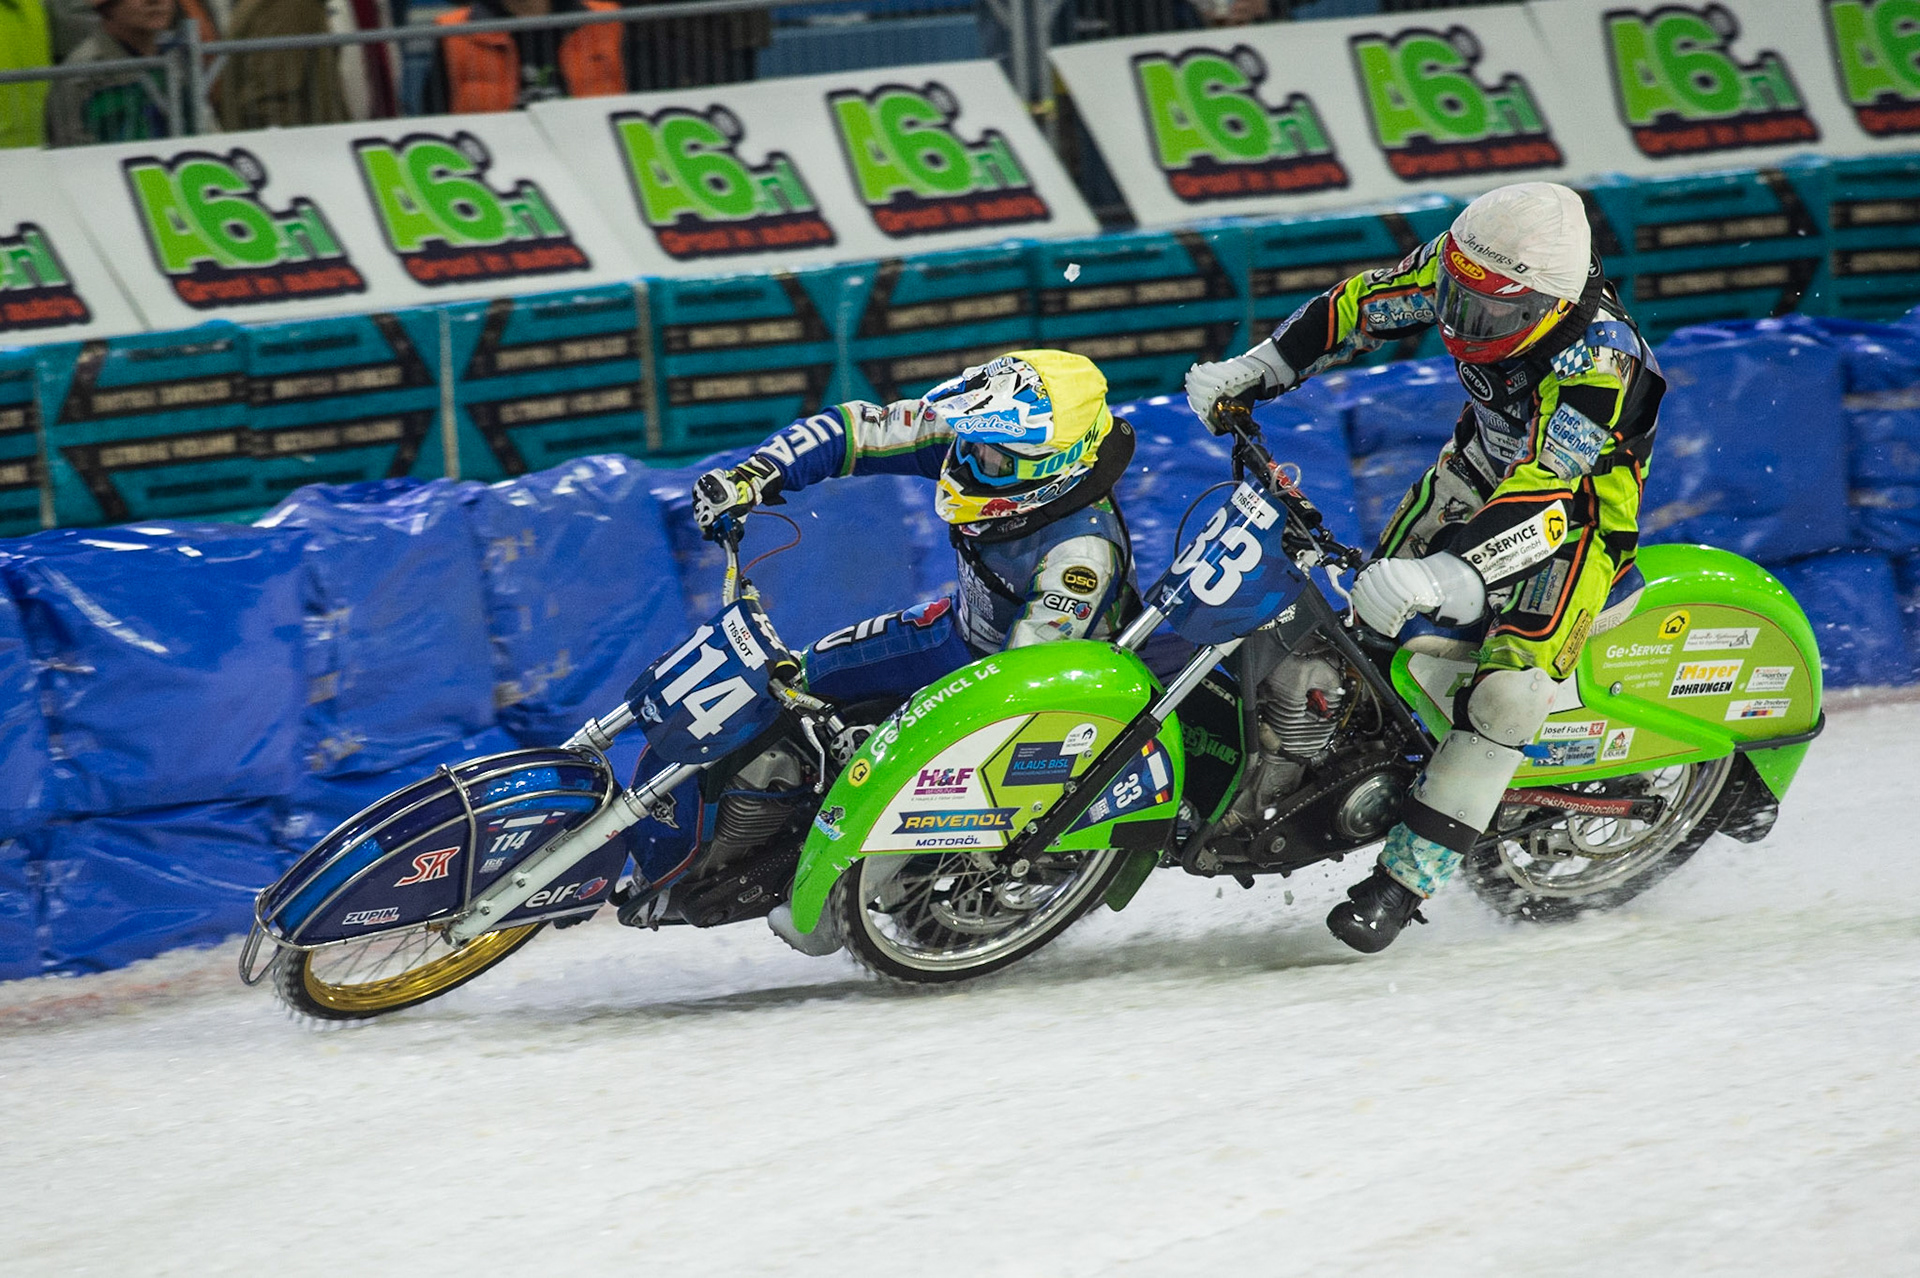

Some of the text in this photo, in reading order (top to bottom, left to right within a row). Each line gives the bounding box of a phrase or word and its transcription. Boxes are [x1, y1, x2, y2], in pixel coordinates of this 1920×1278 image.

[1556, 408, 1581, 430] msc
[756, 414, 844, 467] UFA
[1031, 422, 1099, 478] 100%
[1171, 507, 1262, 606] 33
[1044, 594, 1078, 612] elf
[727, 620, 753, 657] TISSOT
[654, 624, 757, 740] 114
[1681, 664, 1740, 682] Mayer
[1670, 680, 1733, 696] BOHRUNGEN
[901, 677, 973, 729] SERVICE
[1567, 725, 1589, 734] Fuchs
[1013, 758, 1069, 770] KLAUS BISL
[1112, 773, 1143, 809] 33
[489, 830, 533, 853] 114
[915, 835, 981, 847] MOTORÖL
[525, 882, 581, 908] elf
[344, 907, 397, 923] ZUPIN
